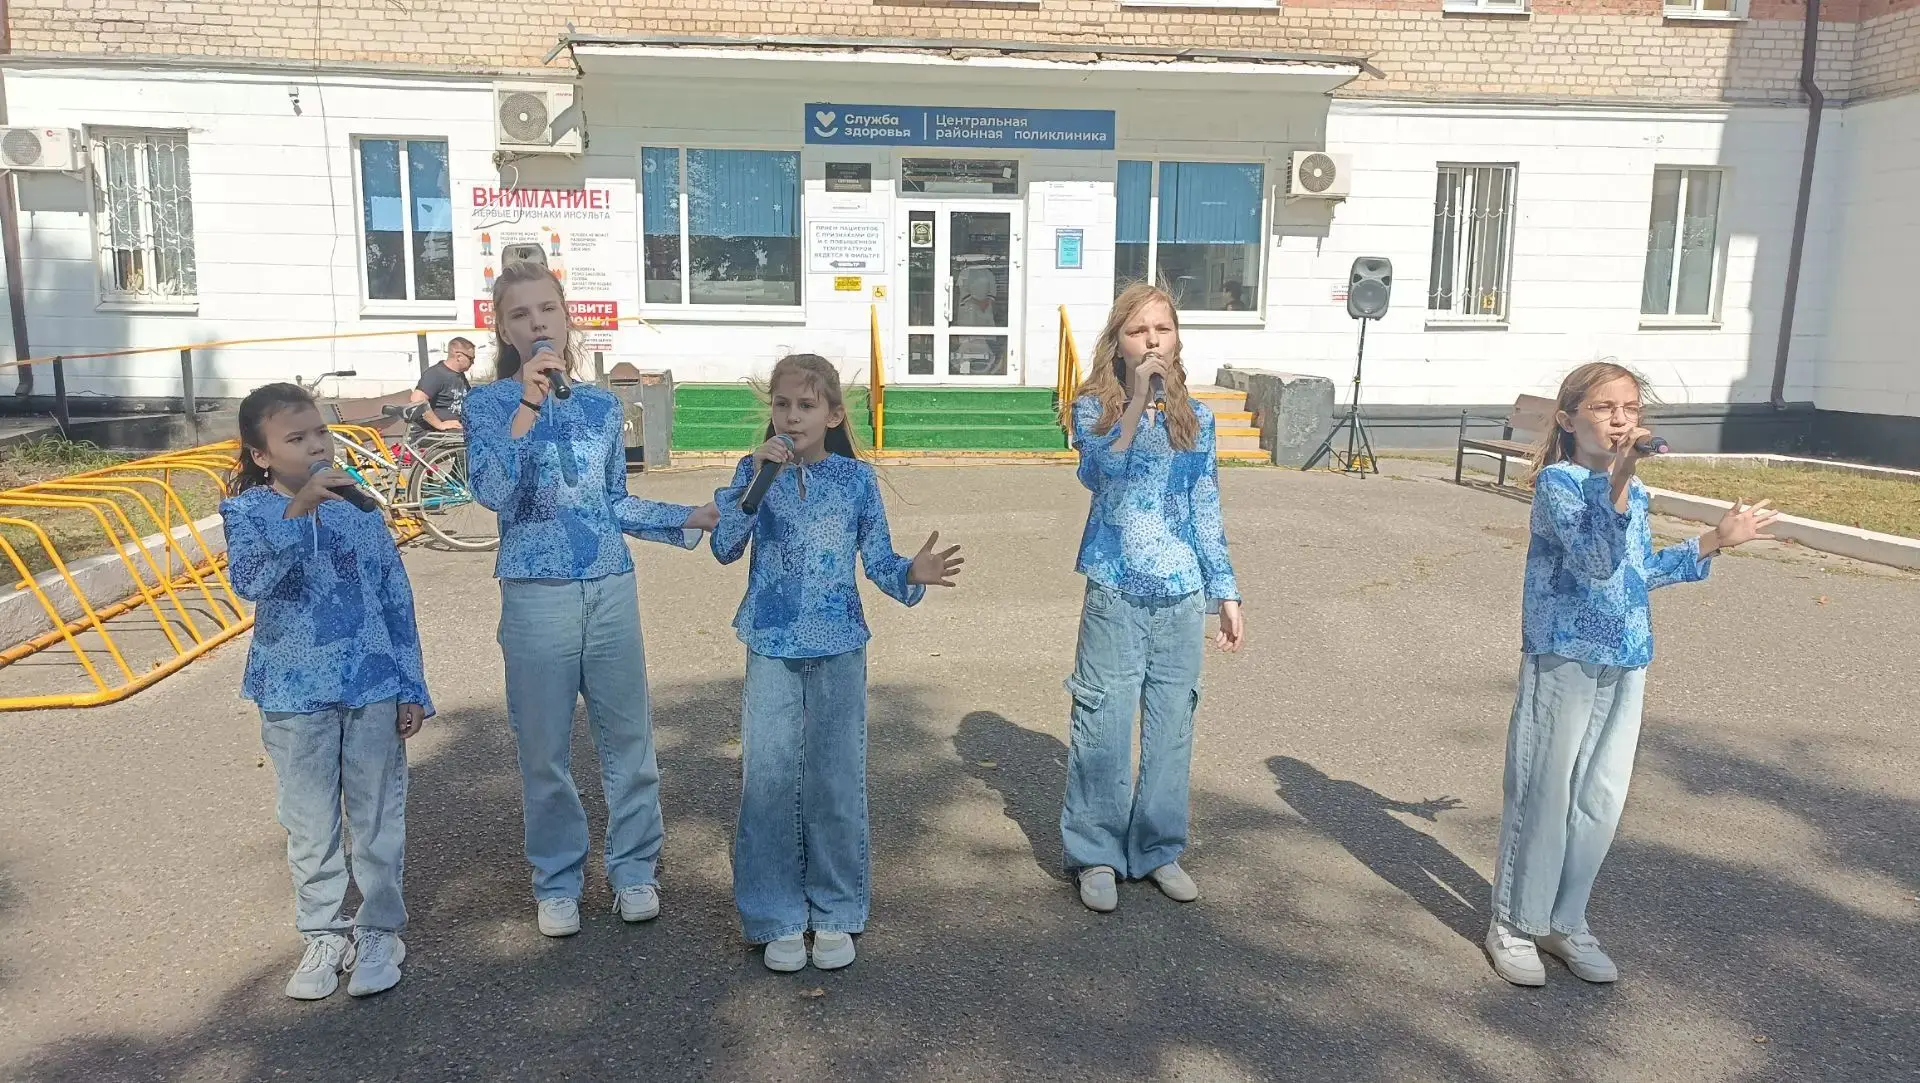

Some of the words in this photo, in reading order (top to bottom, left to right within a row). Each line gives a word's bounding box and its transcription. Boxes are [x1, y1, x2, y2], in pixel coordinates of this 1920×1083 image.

[844, 114, 899, 126] Служба
[936, 114, 1028, 129] Центральная
[844, 127, 911, 139] здоровья
[936, 127, 1003, 140] районная
[1014, 130, 1107, 141] поликлиника
[472, 187, 610, 209] ВНИМАНИЕ!
[474, 209, 511, 218] ПЕРВЫЕ
[513, 209, 561, 219] ПРИЗНАКИ
[564, 210, 611, 220] ИНСУЛЬТА
[568, 303, 613, 314] ОВИТЕ
